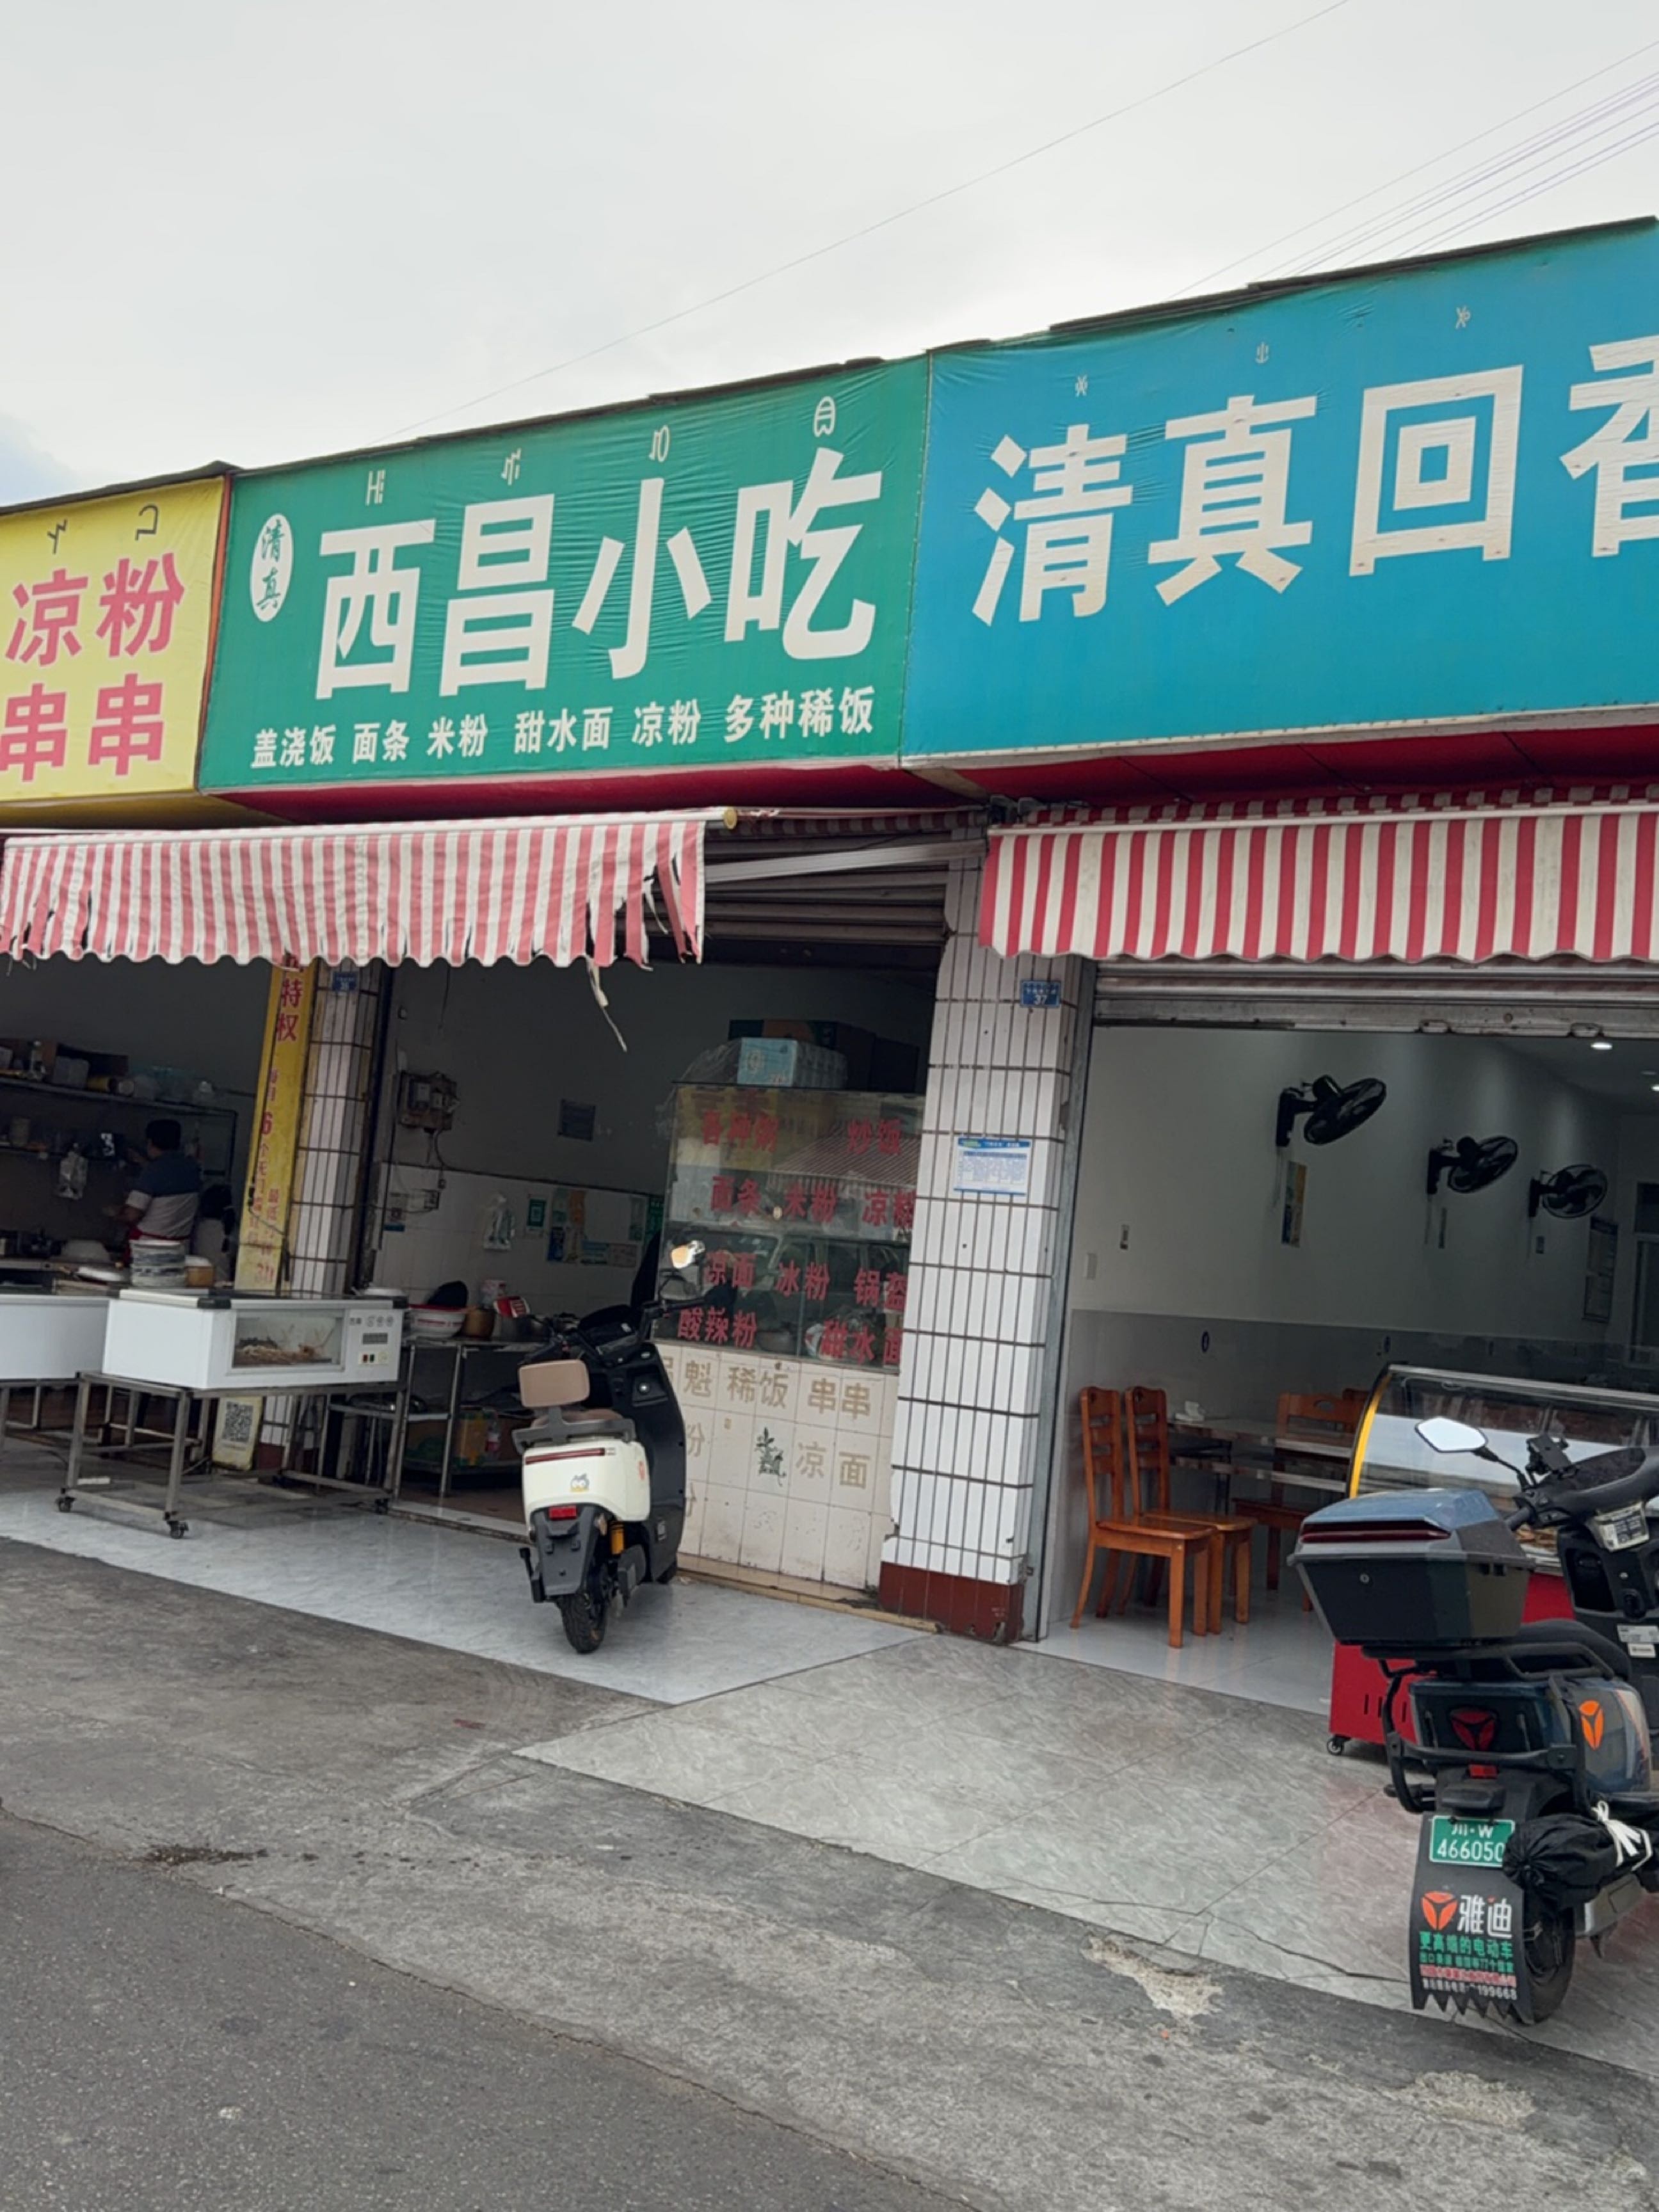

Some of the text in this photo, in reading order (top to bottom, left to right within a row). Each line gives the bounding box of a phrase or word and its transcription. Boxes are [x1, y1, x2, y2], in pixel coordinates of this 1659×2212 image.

[257, 523, 284, 611] 清真
[316, 446, 883, 700] 西昌小吃
[5, 552, 185, 666] 凉粉
[0, 673, 164, 782] 串串
[250, 685, 875, 768] 盖浇饭 面条 米粉 甜水面 凉粉 多种稀饭
[711, 1175, 762, 1216] 面条
[783, 1183, 837, 1223] 米粉
[704, 1249, 757, 1289] 凉面
[775, 1260, 830, 1301] 冰粉
[677, 1306, 757, 1349] 酸辣粉
[663, 1356, 872, 1420] 魁 稀饭 串串
[796, 1441, 871, 1490] 凉面
[1437, 1838, 1505, 1863] 466050
[1457, 1894, 1513, 1939] 雅迪
